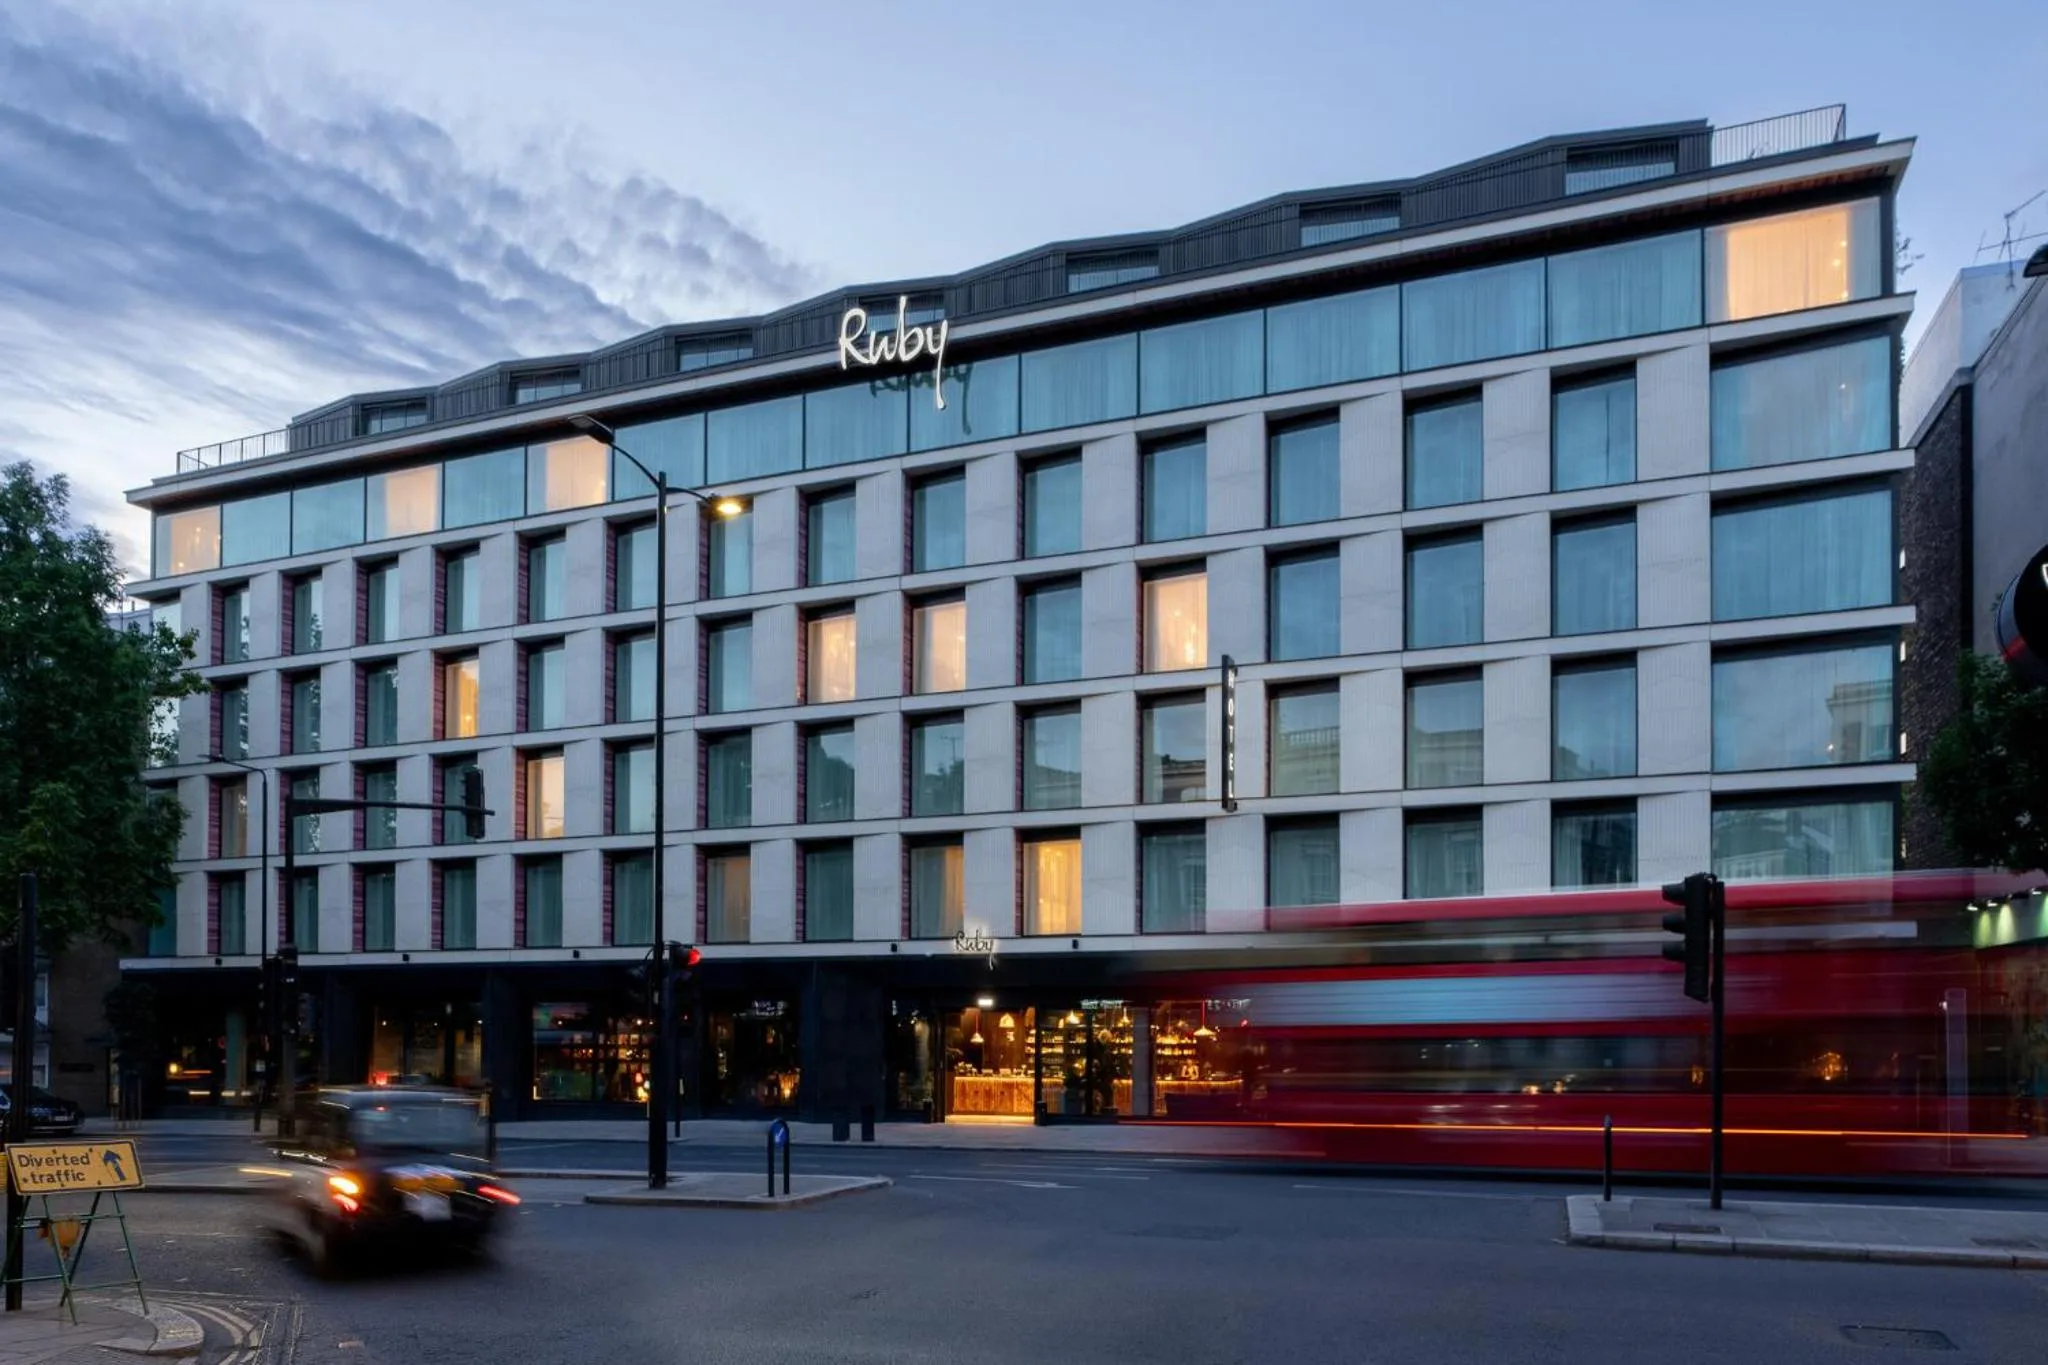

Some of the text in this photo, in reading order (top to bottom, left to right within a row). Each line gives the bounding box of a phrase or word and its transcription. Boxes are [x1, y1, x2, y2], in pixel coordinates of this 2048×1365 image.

[839, 296, 948, 409] Ruby
[1227, 668, 1235, 799] HOTEL
[952, 929, 994, 970] Ruby
[17, 1153, 91, 1168] Diverted
[30, 1169, 86, 1184] traffic
